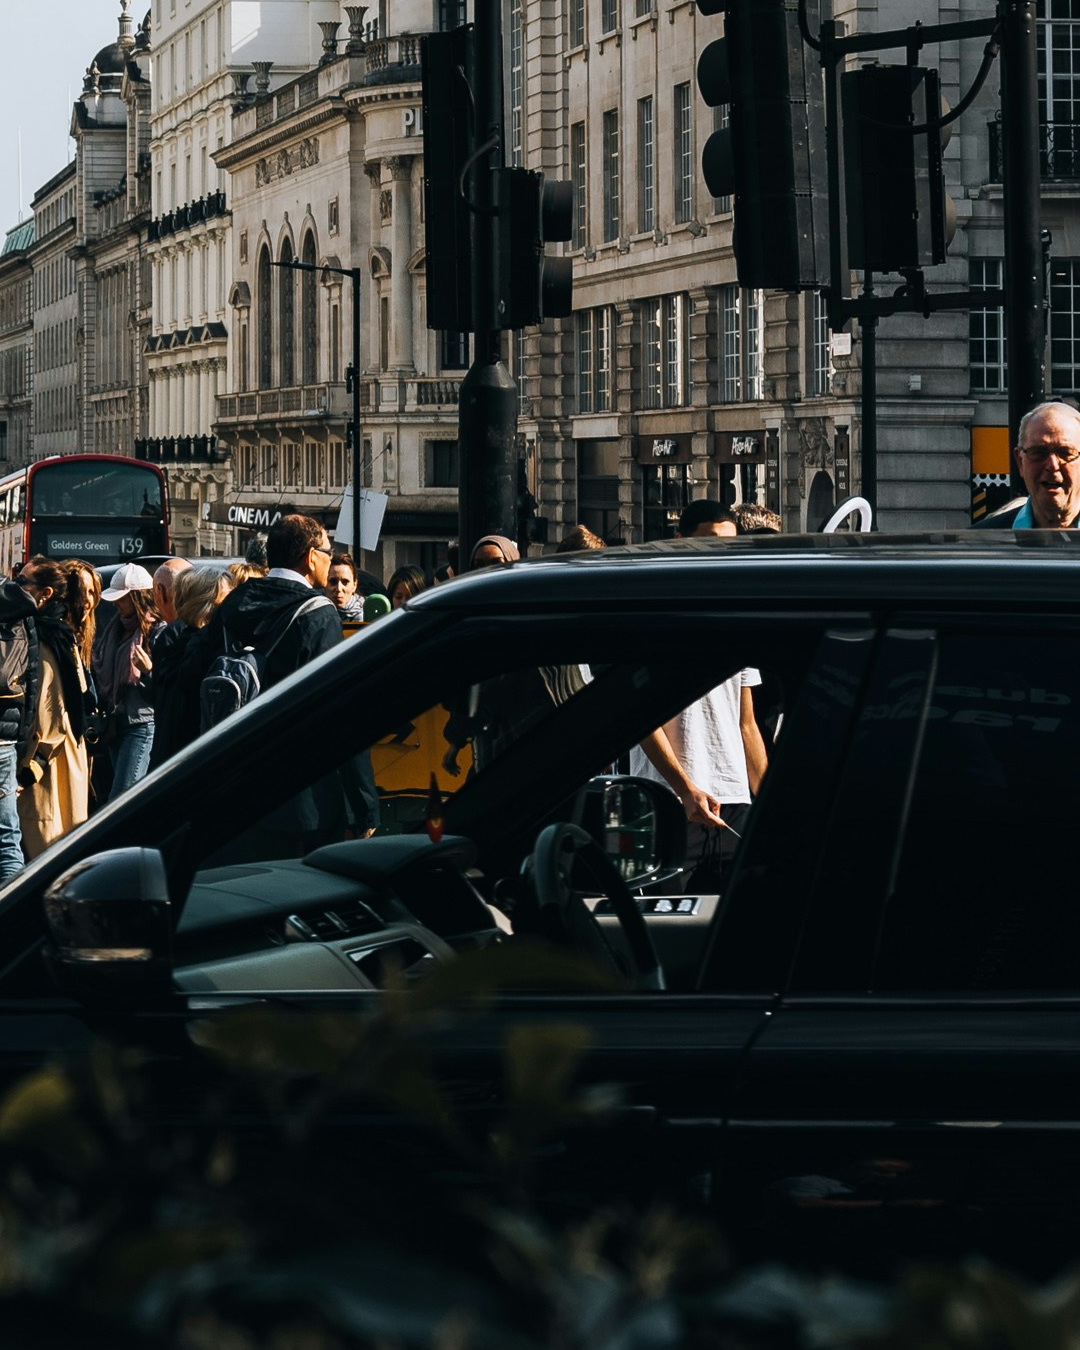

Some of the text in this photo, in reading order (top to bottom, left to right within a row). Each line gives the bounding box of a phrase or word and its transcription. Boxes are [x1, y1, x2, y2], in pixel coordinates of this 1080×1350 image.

[228, 506, 282, 526] CINEMA
[51, 538, 143, 553] Golders Green 139
